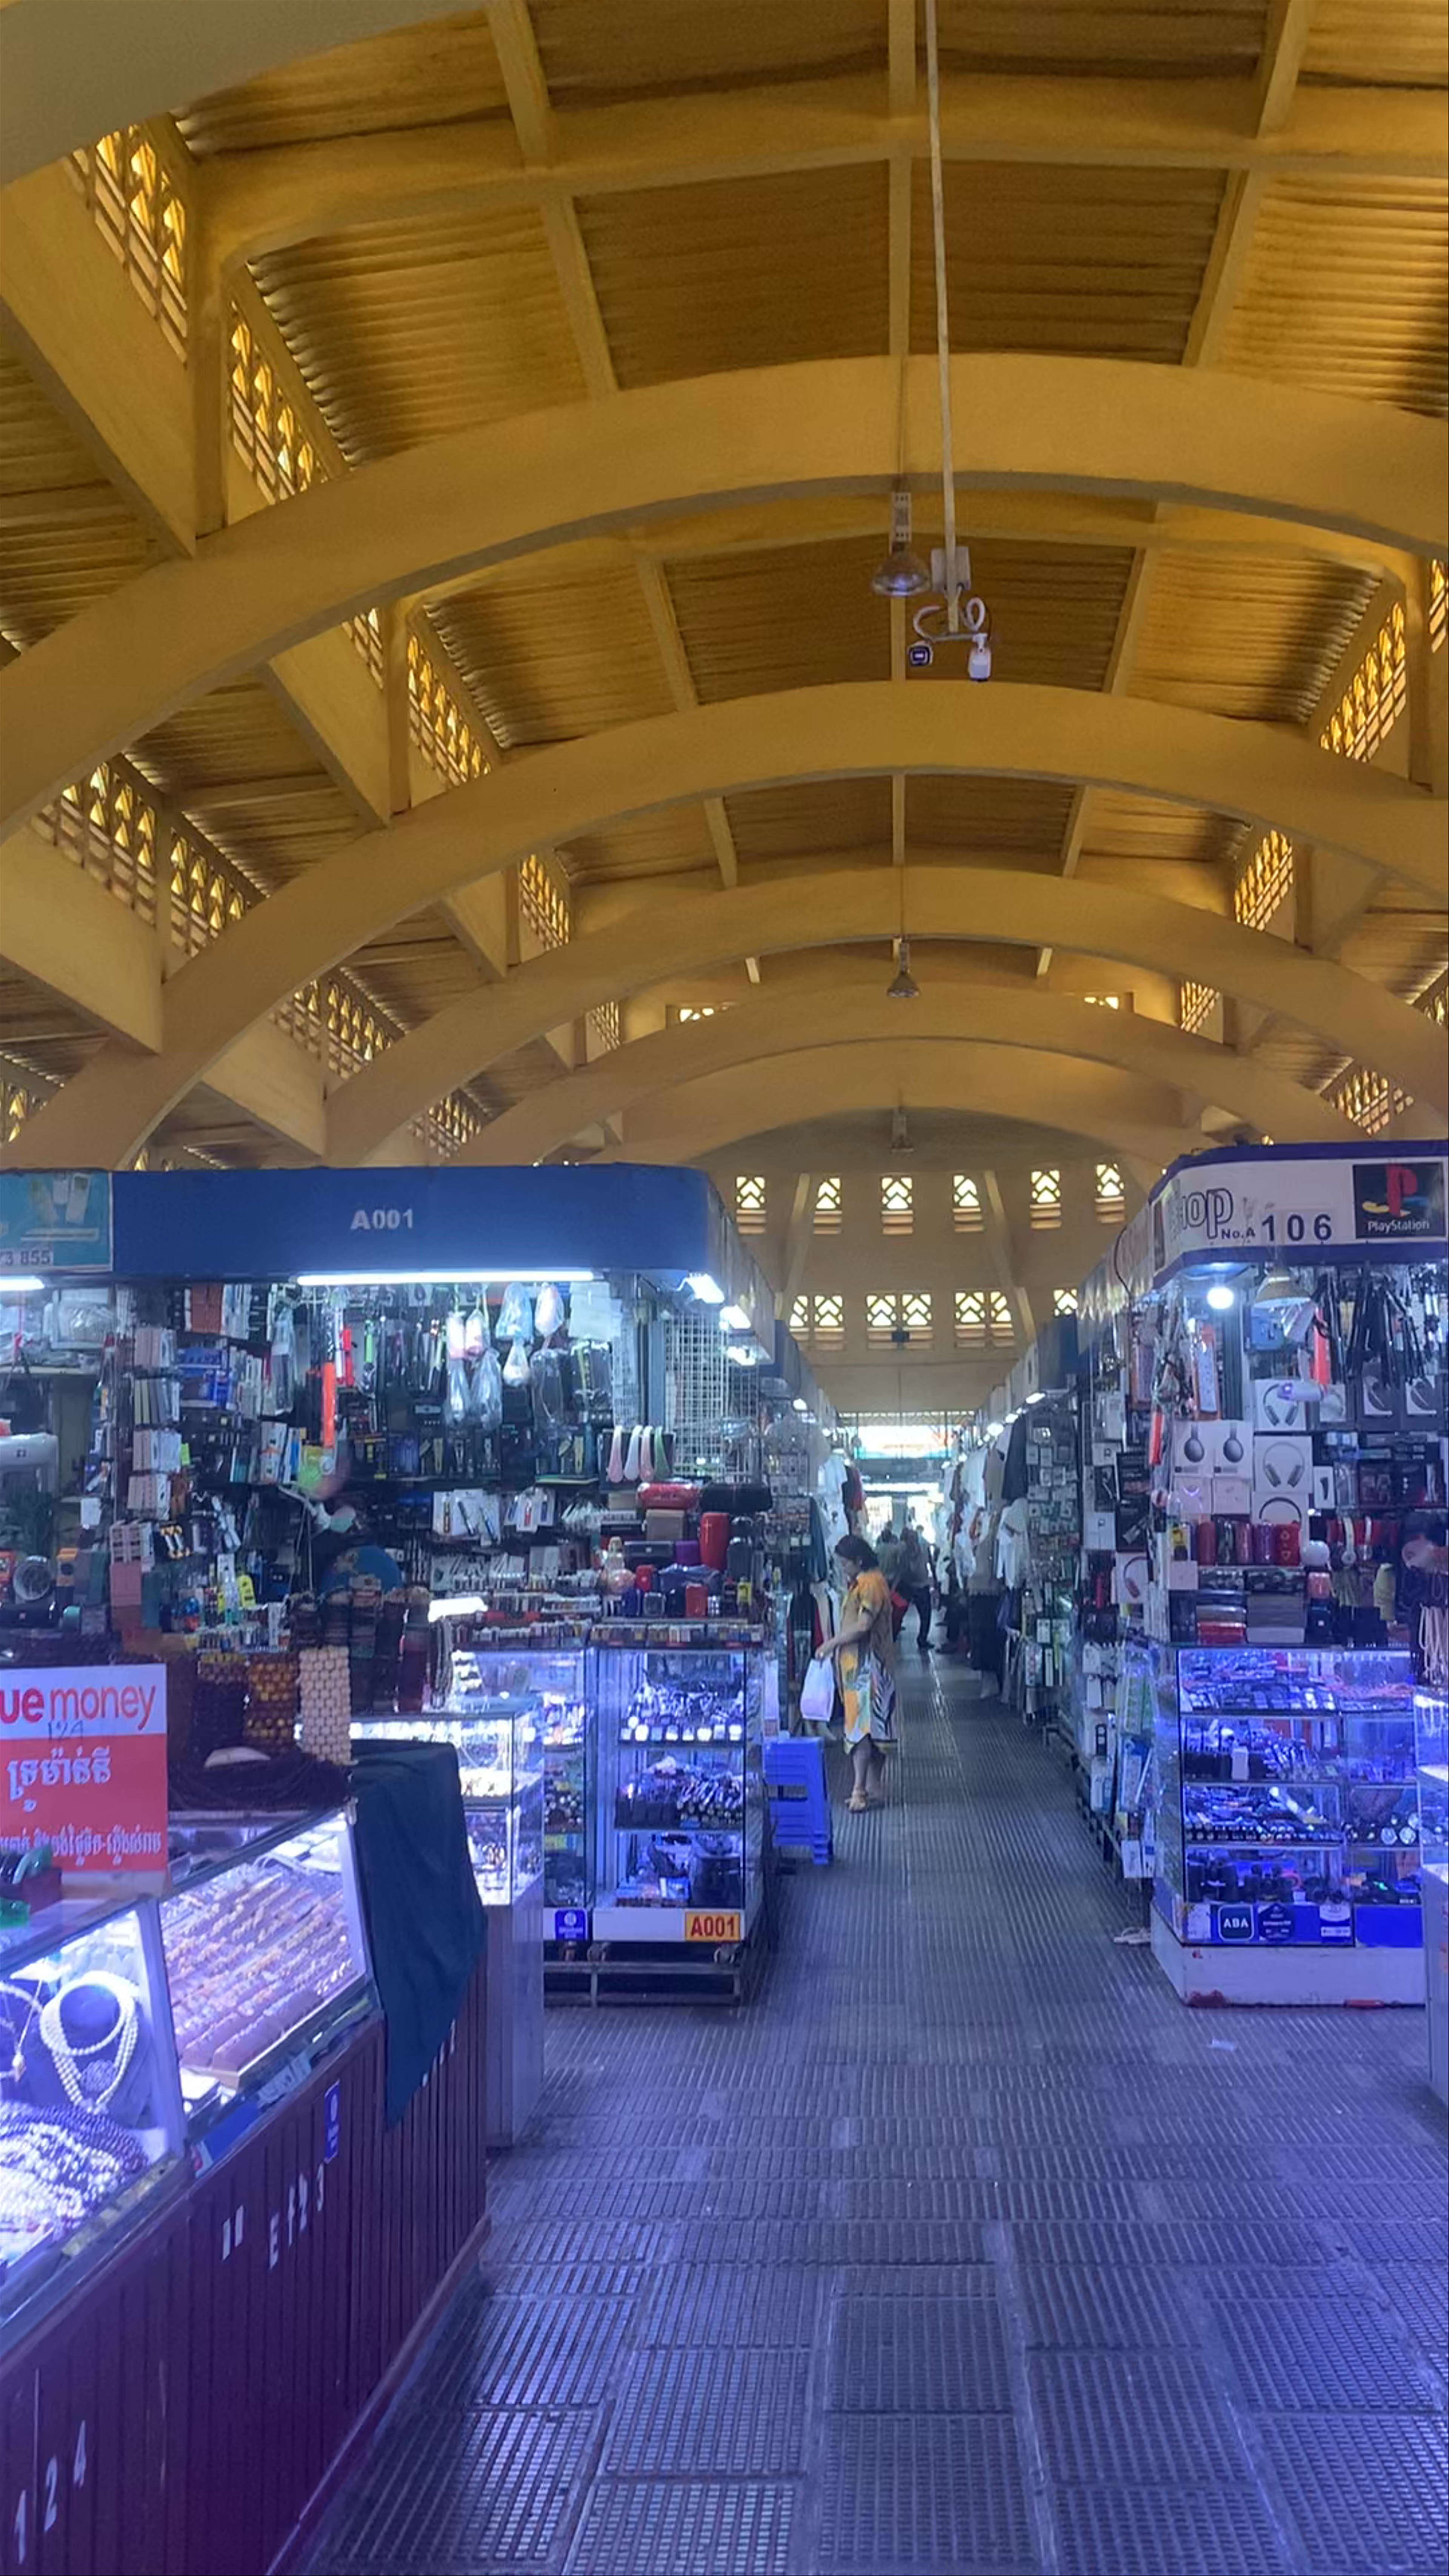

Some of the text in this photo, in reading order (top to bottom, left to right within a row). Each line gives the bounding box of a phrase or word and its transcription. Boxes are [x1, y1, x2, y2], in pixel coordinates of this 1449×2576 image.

[349, 1208, 413, 1229] A001
[1367, 1220, 1430, 1234] PlayStation
[50, 1684, 155, 1731] money
[691, 1916, 734, 1937] A001
[1223, 1917, 1249, 1928] ABA
